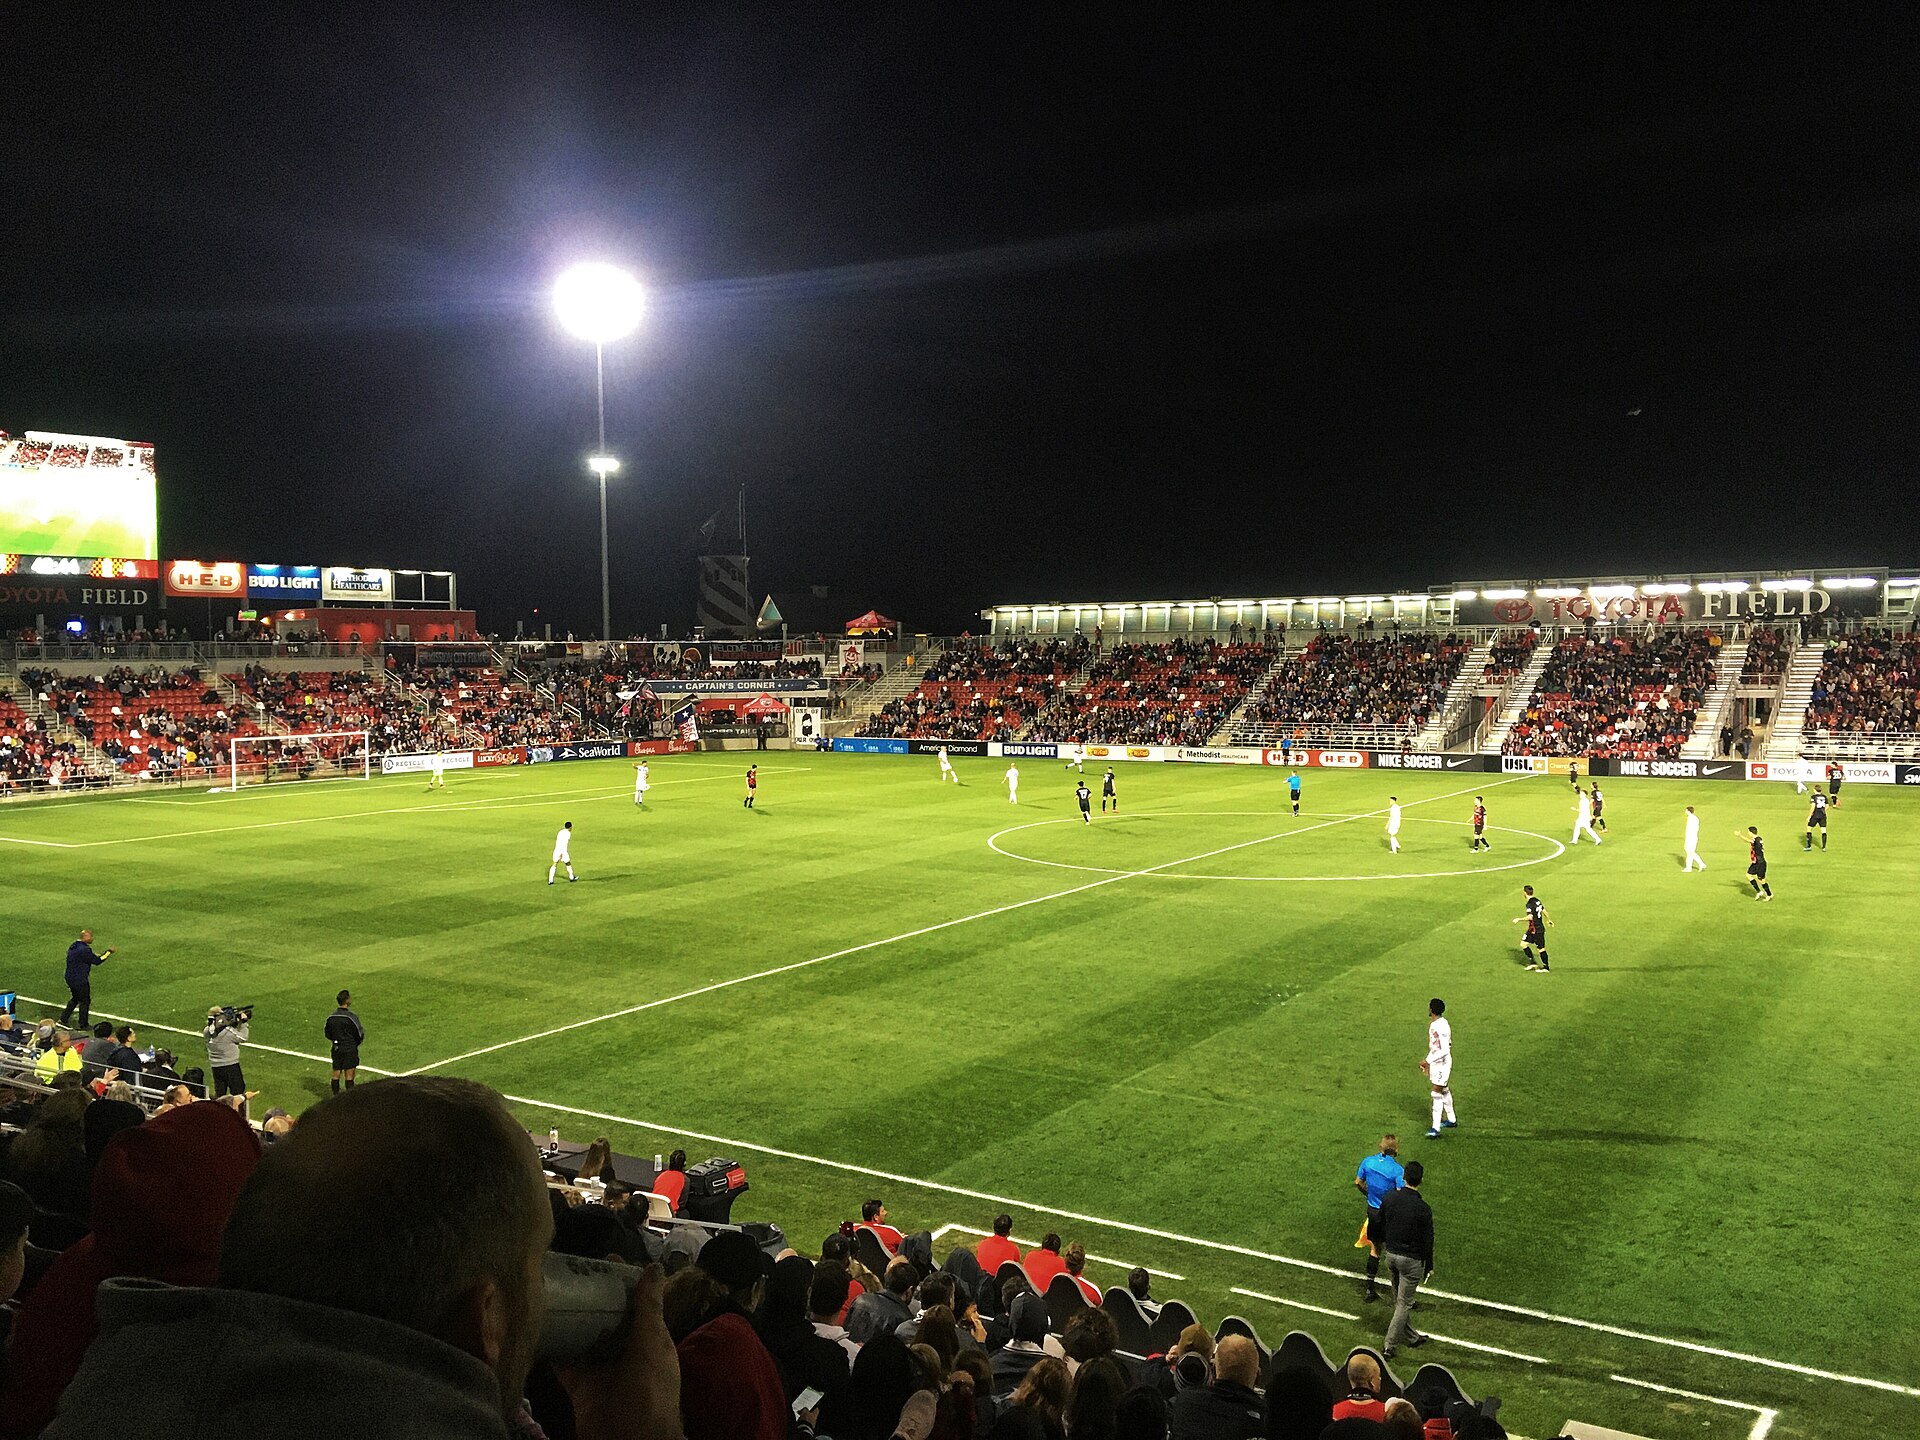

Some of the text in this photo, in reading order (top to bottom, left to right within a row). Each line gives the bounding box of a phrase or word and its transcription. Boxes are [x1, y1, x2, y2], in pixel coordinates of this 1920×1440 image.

[248, 576, 320, 589] BUD LIGHT
[333, 579, 382, 590] HEALTHCARE
[0, 585, 148, 605] OYOTA FIELD
[1546, 588, 1831, 621] TOYOTA FIELD
[102, 646, 116, 654] 115
[287, 645, 299, 653] 116
[752, 644, 761, 652] TO
[685, 681, 776, 690] CAPTAIN'S CORNER
[578, 745, 621, 758] SeaWorld
[919, 744, 978, 753] Americ Diamond
[1003, 745, 1056, 757] BUD LIGHT
[477, 754, 496, 763] LUCKY
[1186, 750, 1221, 759] Methodist
[1378, 755, 1443, 769] NIKE SOCCER
[1620, 761, 1697, 777] NIKE SOCCER
[1848, 769, 1890, 777] TOYOTA
[1903, 774, 1920, 784] SW
